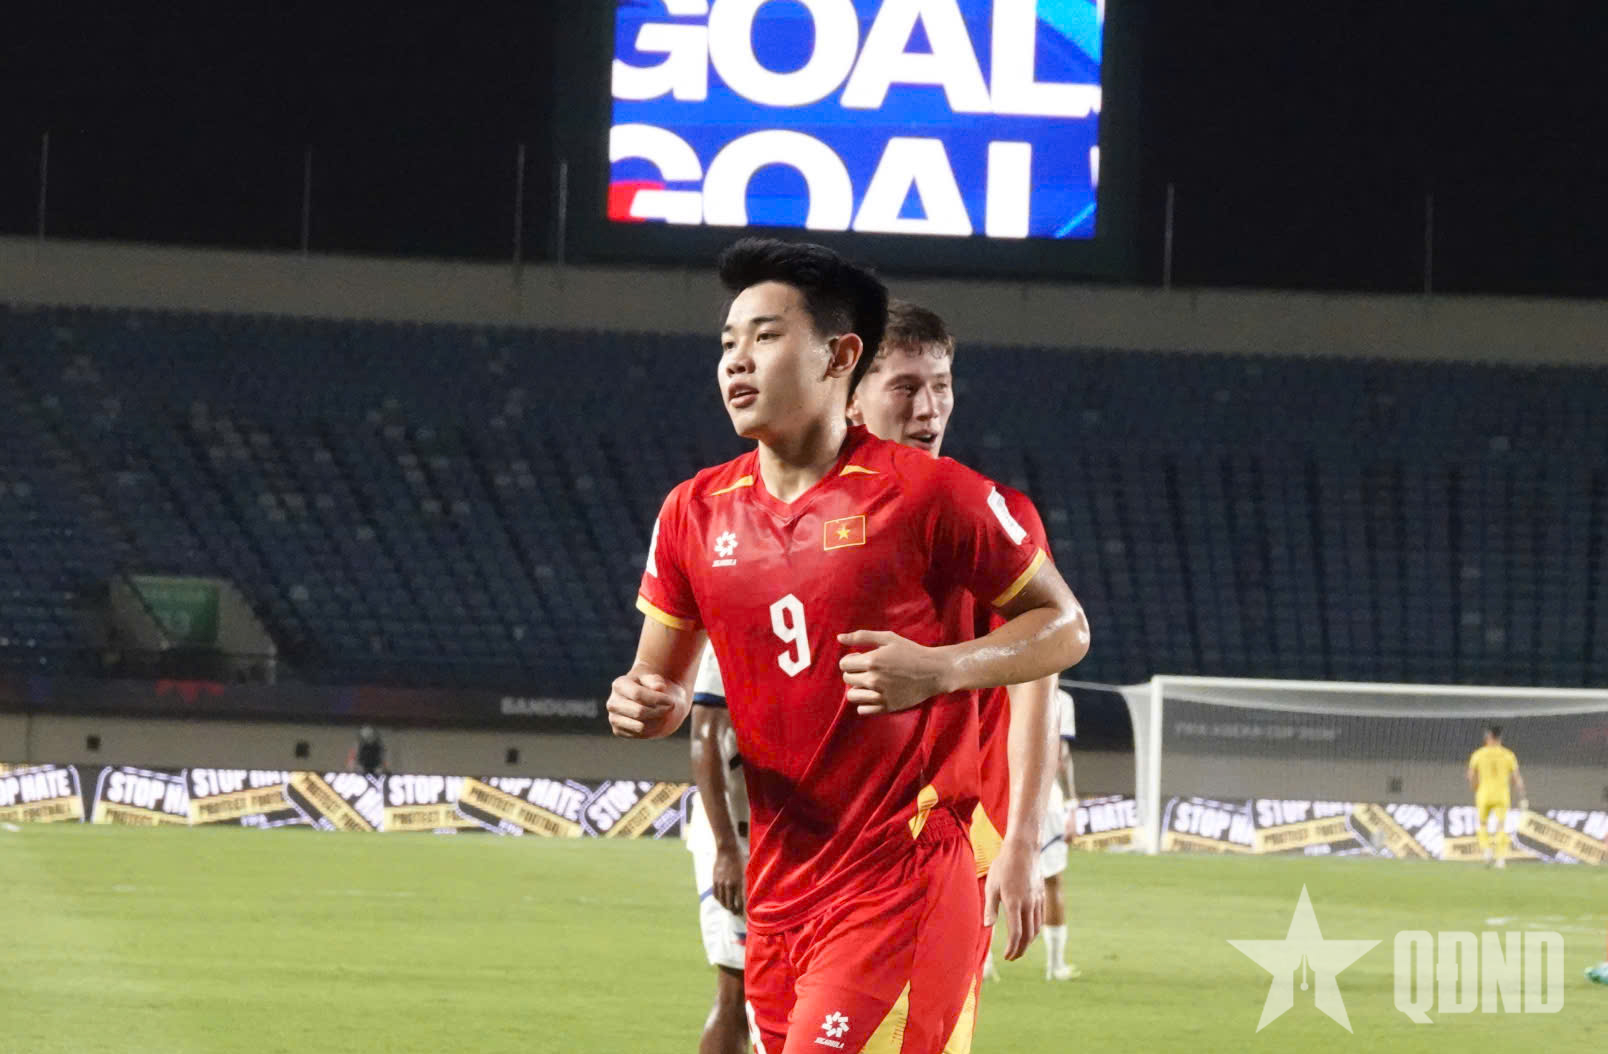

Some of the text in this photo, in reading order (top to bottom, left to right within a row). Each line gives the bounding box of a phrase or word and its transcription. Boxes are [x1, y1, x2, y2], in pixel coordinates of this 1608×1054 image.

[612, 0, 1101, 118] GOAL
[608, 123, 1100, 238] GOAL
[769, 593, 812, 678] 9
[107, 771, 165, 810] STOP
[388, 774, 444, 806] STOP
[1174, 802, 1230, 839] STOP
